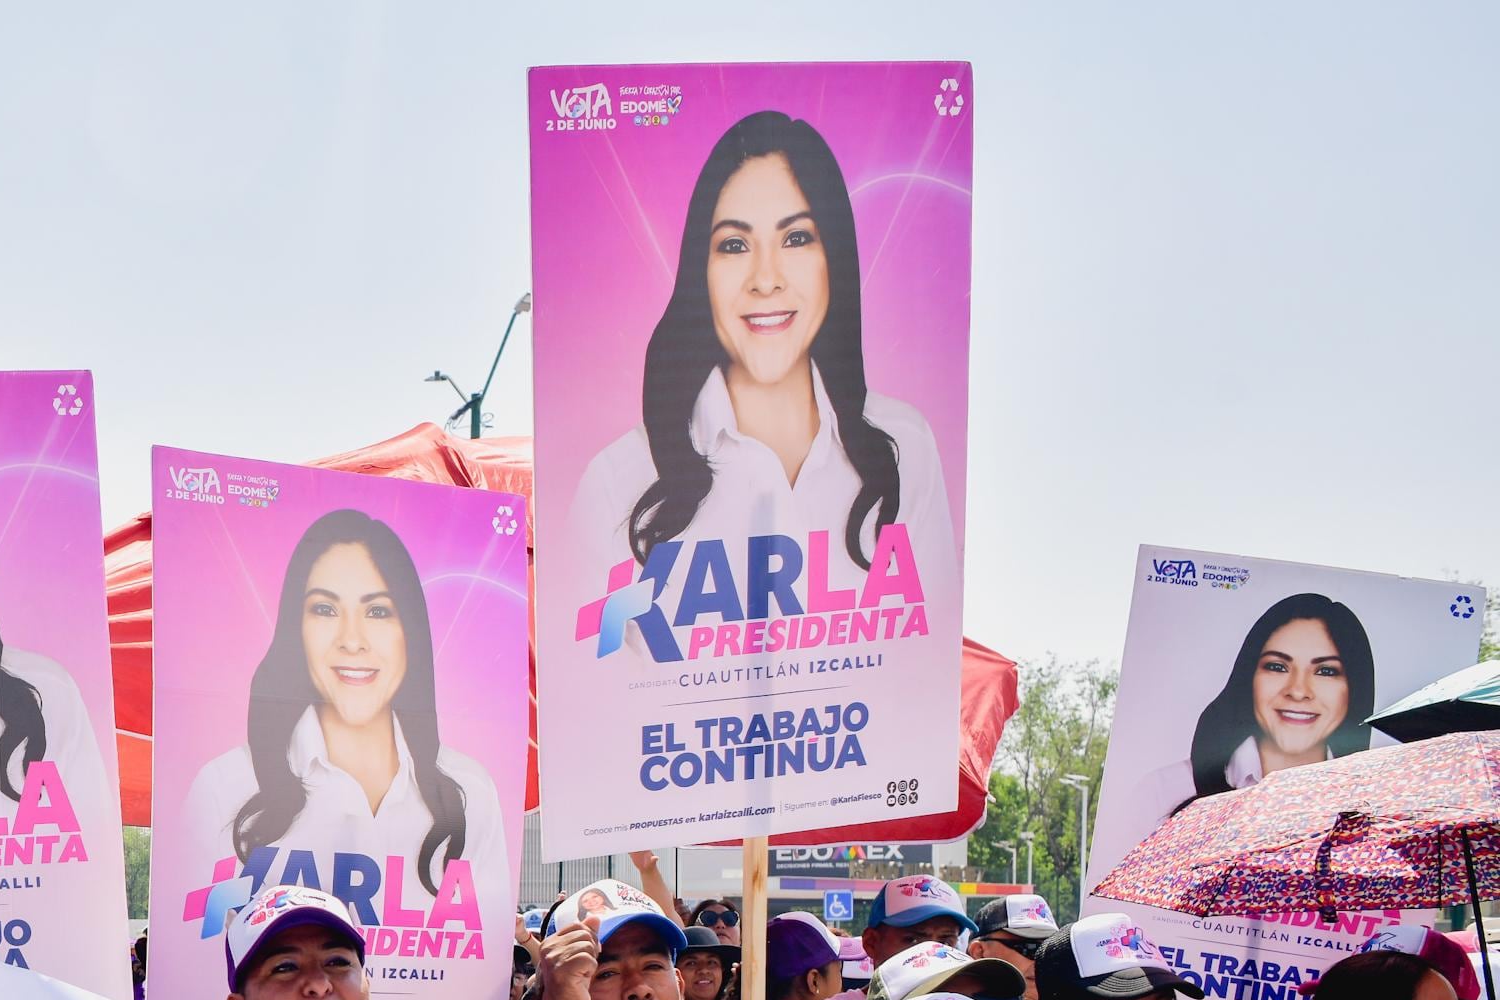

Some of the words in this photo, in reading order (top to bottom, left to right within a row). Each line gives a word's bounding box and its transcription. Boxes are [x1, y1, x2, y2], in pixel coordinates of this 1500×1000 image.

[550, 83, 612, 119] VOTA
[546, 120, 554, 131] 2
[557, 120, 574, 130] DE
[578, 118, 616, 130] JUNIO
[169, 466, 221, 494] VOTA
[166, 489, 173, 498] 2
[176, 490, 190, 500] DE
[192, 492, 225, 505] JUNIO
[1153, 559, 1196, 579] VOTA
[597, 523, 925, 663] KARLA
[1170, 577, 1198, 587] JUNIO
[687, 605, 929, 660] PRESIDENTA
[679, 662, 800, 688] CUAUTITLÁN
[809, 654, 883, 674] IZCALLI
[642, 722, 686, 755] EL
[695, 701, 869, 749] TRABAJO
[629, 817, 684, 831] PROPUESTAS
[698, 805, 776, 822] karlaizcalli.com
[1192, 919, 1297, 943] CUAUTITLÁN
[1158, 946, 1192, 969] EL
[382, 967, 445, 981] IZCALLI
